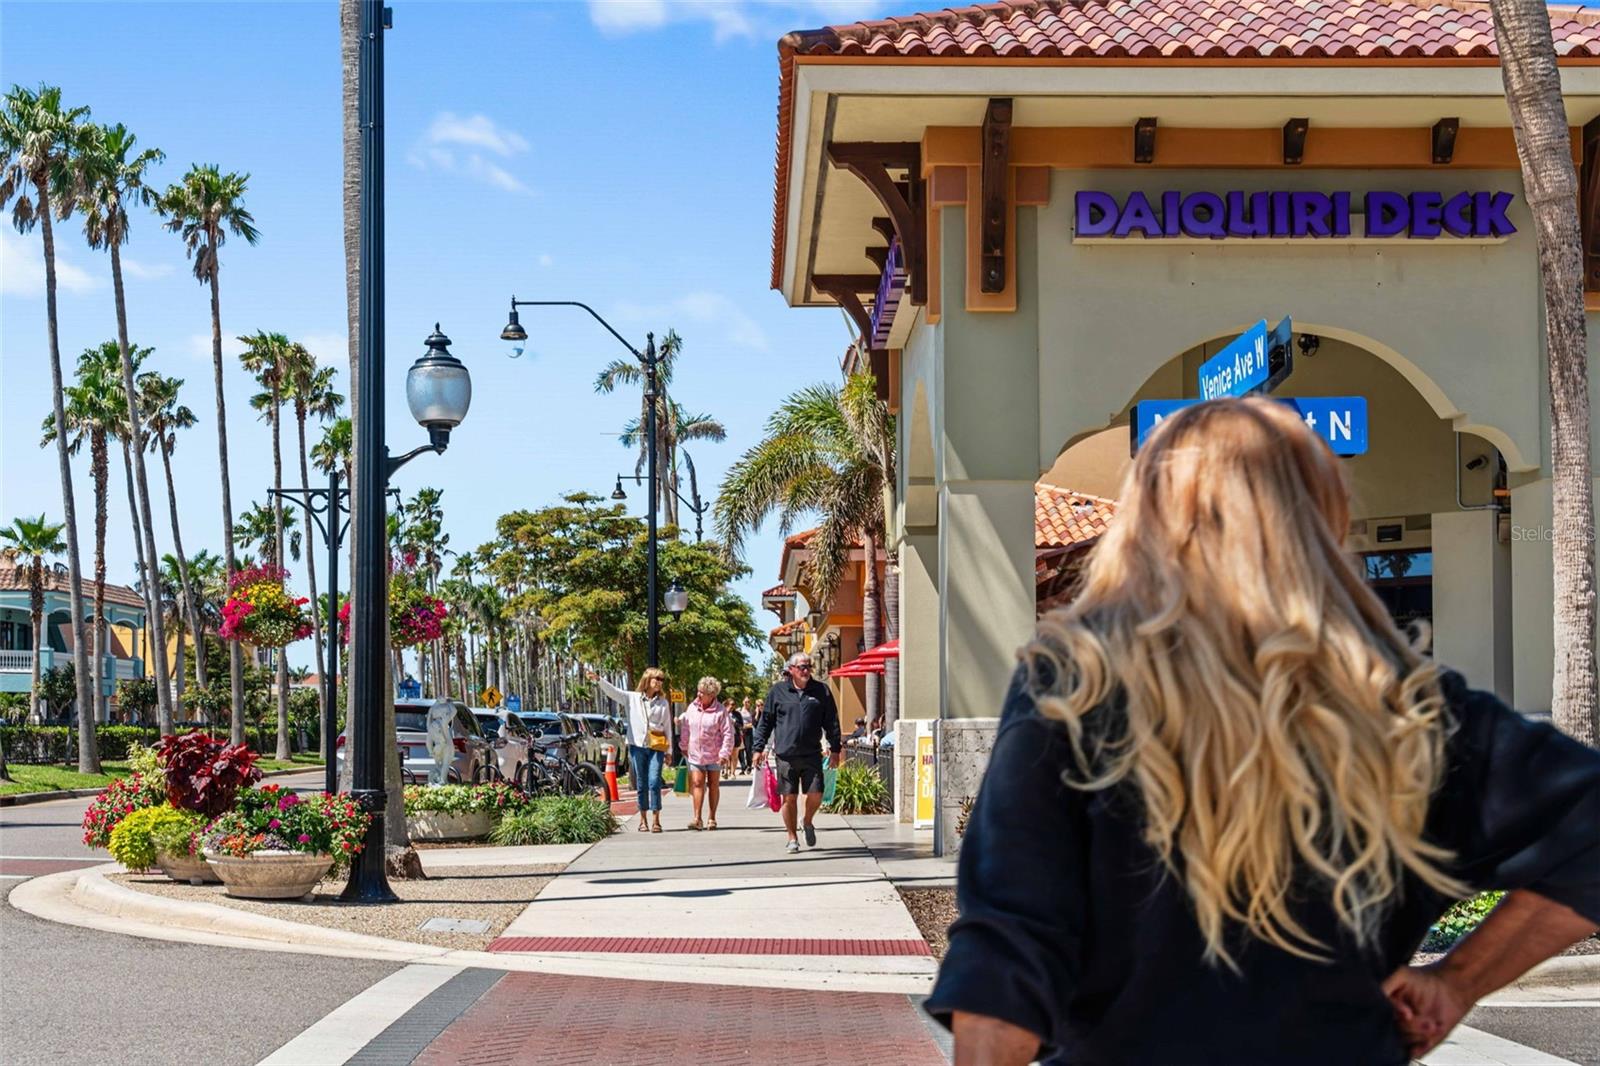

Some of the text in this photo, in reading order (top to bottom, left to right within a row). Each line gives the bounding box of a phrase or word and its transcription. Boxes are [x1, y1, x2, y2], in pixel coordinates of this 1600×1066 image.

[1075, 191, 1517, 238] DAIQUIRI DECK
[1202, 334, 1264, 400] Venice Ave W
[1330, 411, 1351, 441] N
